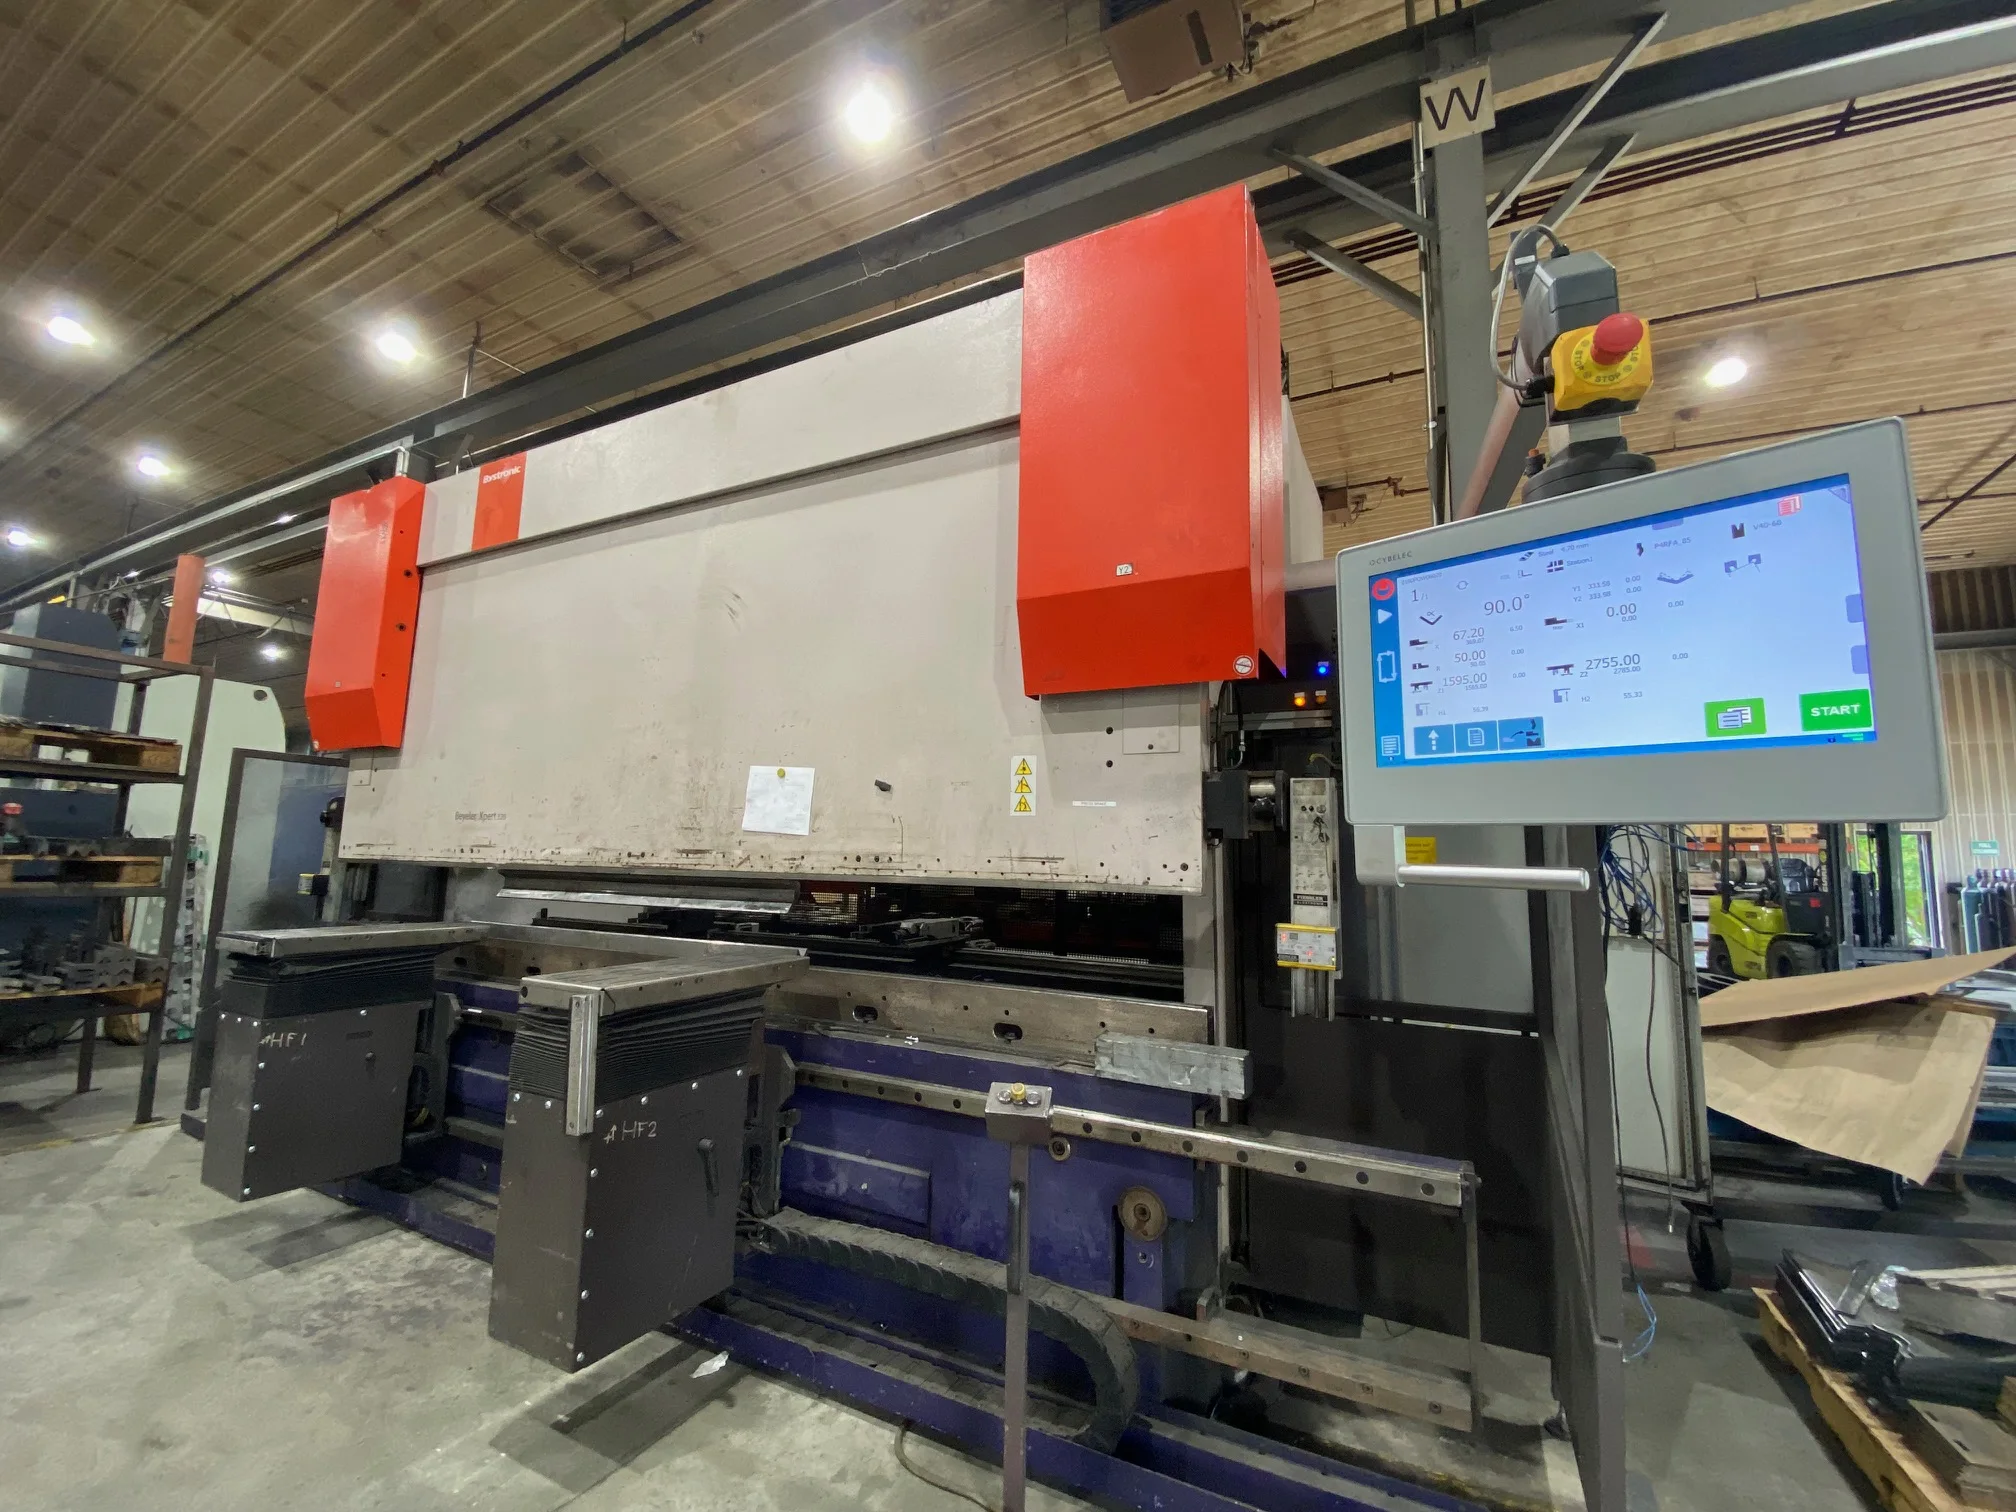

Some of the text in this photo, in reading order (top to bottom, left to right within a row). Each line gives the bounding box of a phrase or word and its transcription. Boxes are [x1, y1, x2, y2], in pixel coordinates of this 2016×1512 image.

[1425, 79, 1486, 131] W
[1595, 373, 1622, 383] STOP
[1119, 566, 1129, 574] Y2
[1625, 575, 1641, 583] 0.00
[1606, 603, 1637, 617] 0.00
[1668, 600, 1684, 608] 0.00
[1453, 627, 1485, 640] 67.20
[1454, 650, 1486, 663] 50.00
[1585, 653, 1641, 670] 2755.00
[1442, 672, 1488, 687] 1595.00
[1810, 703, 1861, 717] START
